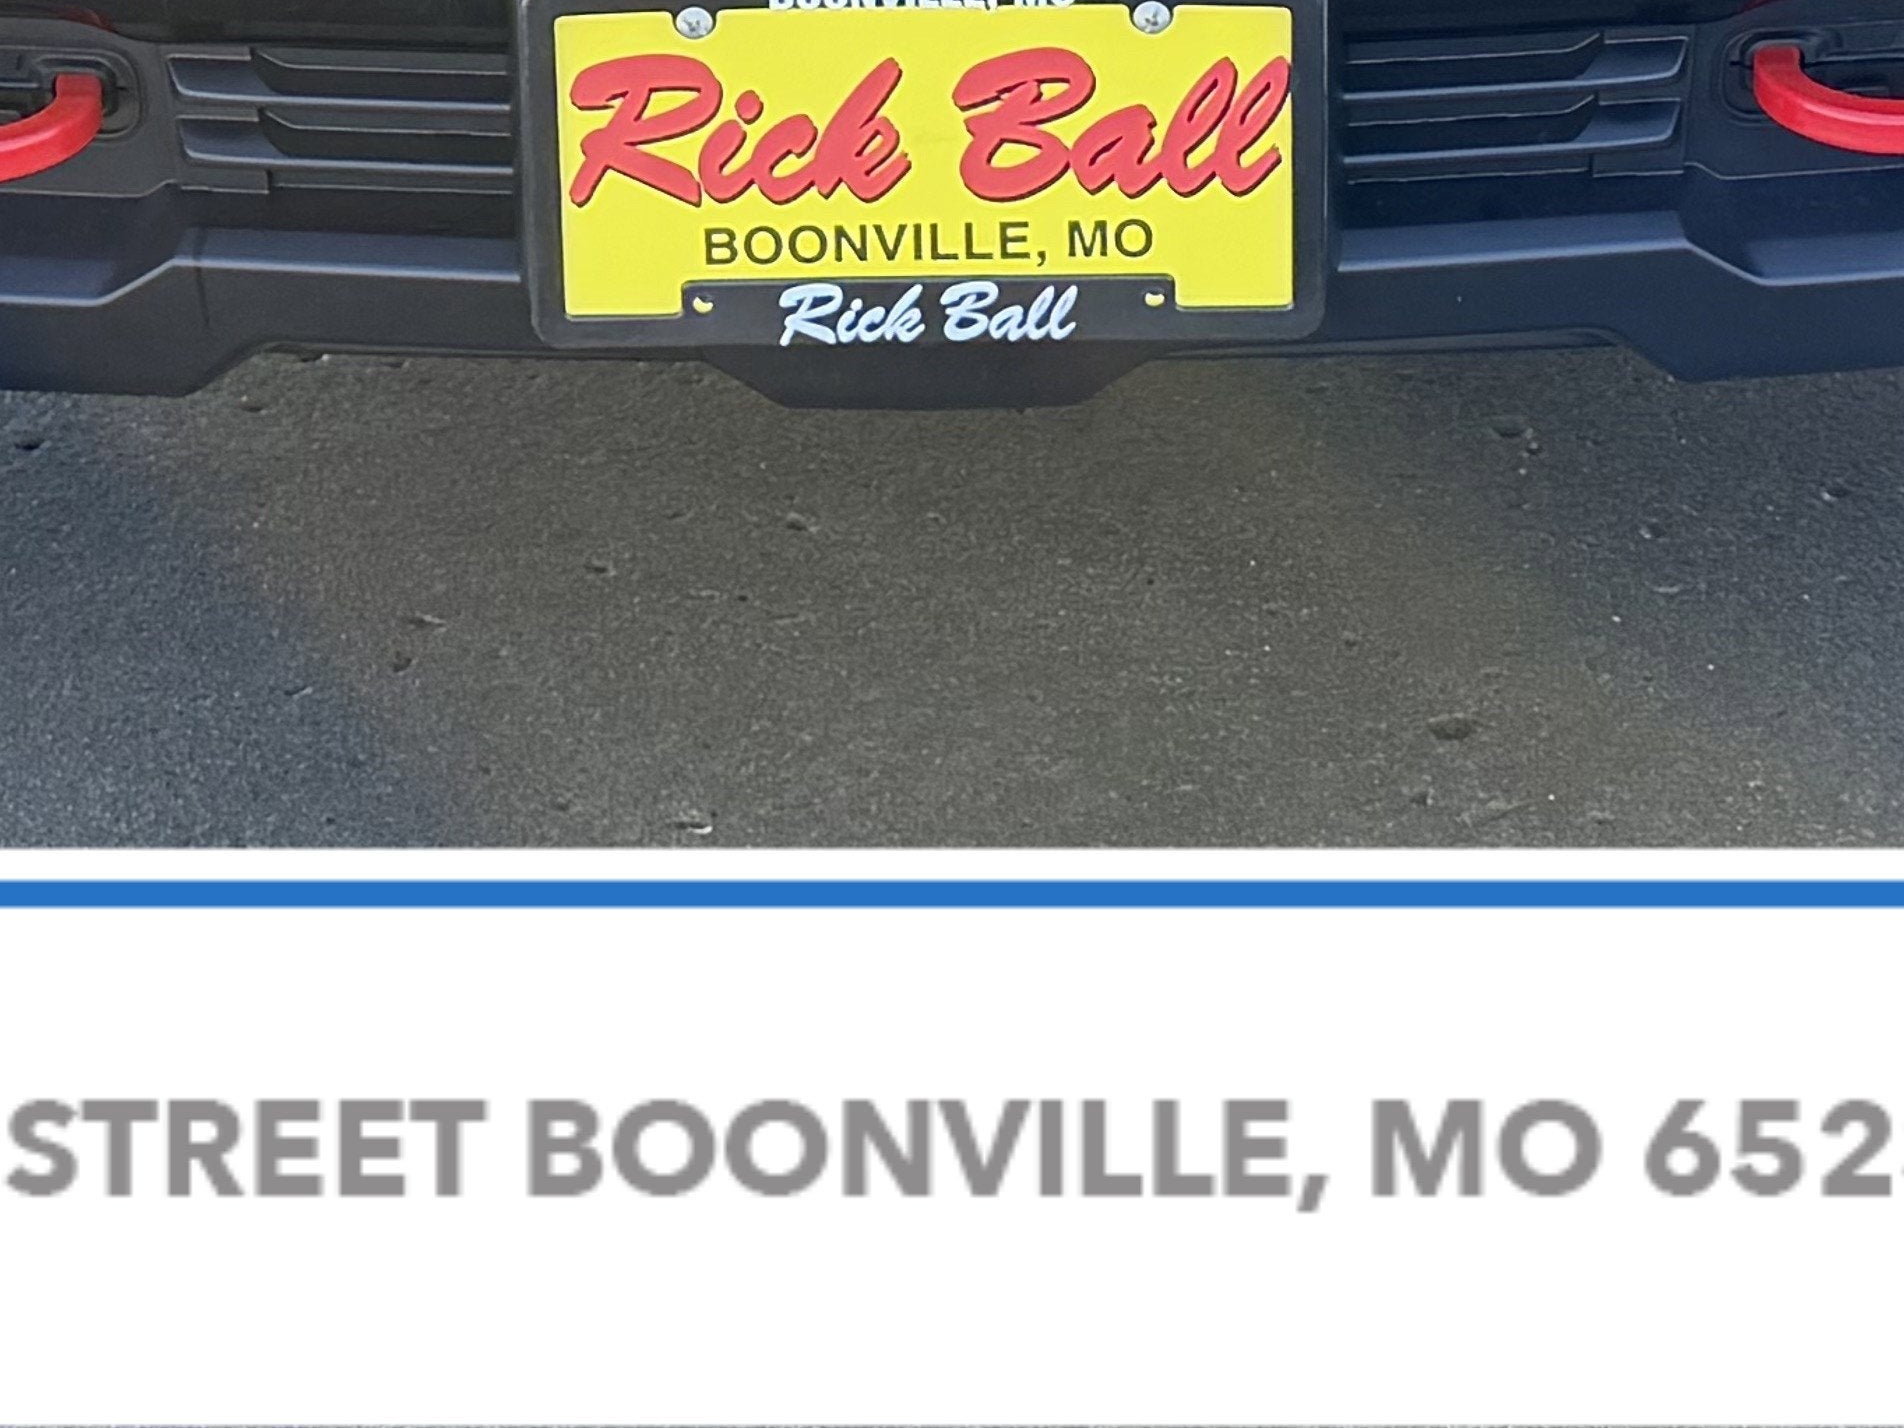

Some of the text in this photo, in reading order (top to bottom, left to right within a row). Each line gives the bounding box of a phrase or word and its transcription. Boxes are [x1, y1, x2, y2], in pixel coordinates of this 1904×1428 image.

[568, 46, 1292, 208] Rick Ball
[704, 218, 1153, 267] BOONVILLE, MO
[779, 282, 1076, 346] Rick Ball
